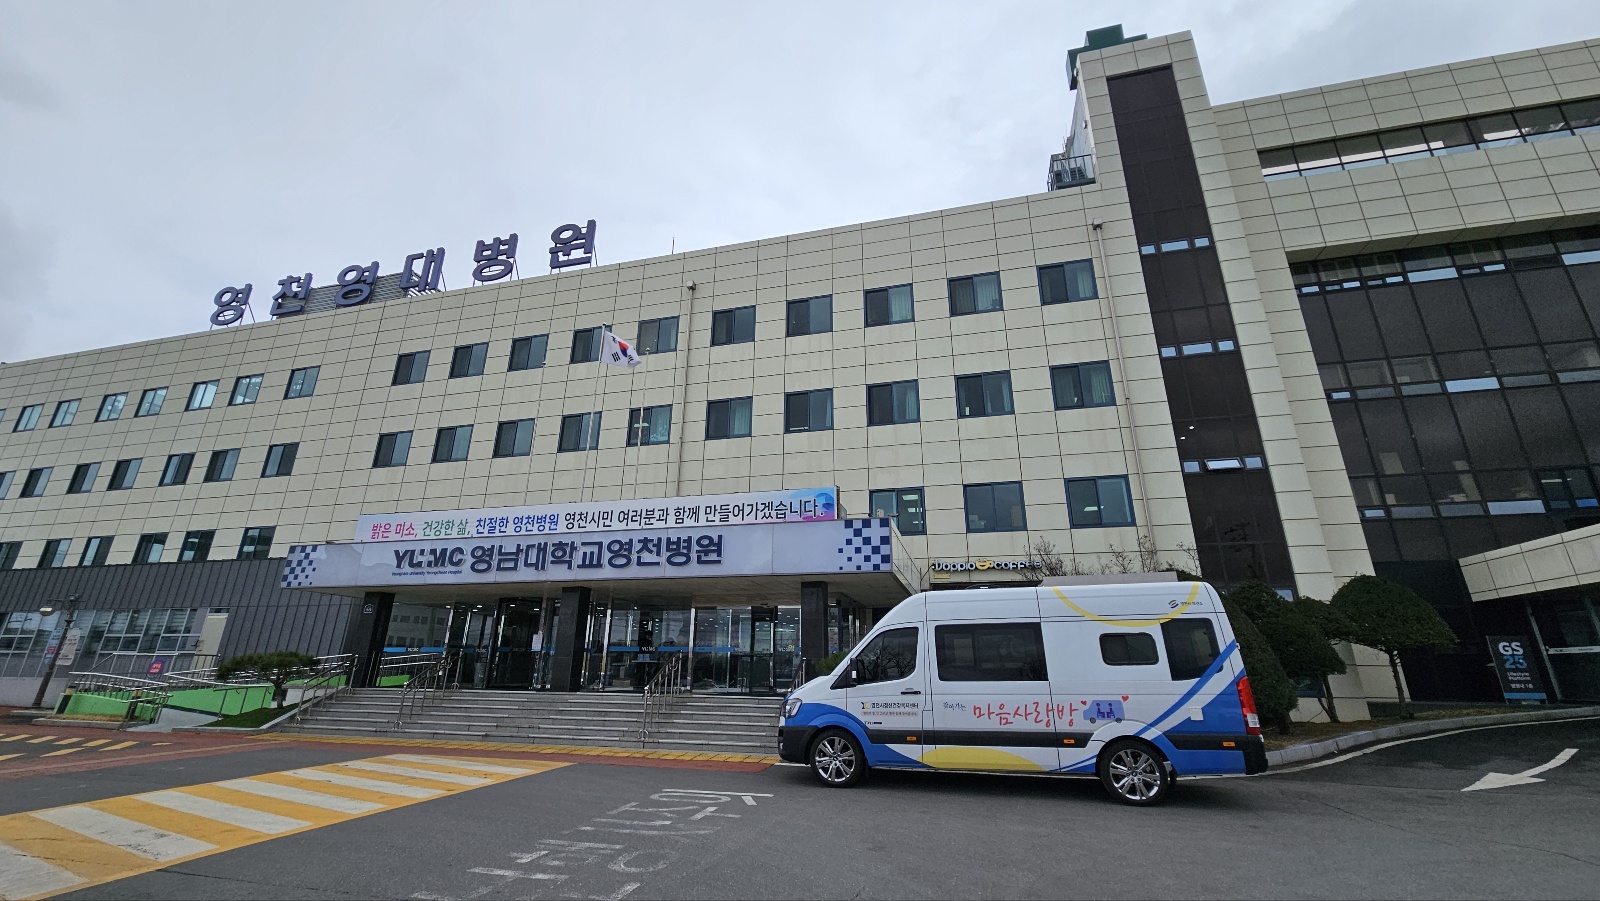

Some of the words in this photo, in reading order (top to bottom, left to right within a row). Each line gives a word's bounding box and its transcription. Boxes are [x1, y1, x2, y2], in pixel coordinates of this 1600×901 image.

[209, 219, 597, 327] 영천영대병원
[371, 522, 392, 540] 밝은
[394, 521, 418, 539] 미소,
[422, 519, 455, 537] 건강한
[475, 516, 510, 536] 친절한
[513, 513, 560, 534] 영천병원
[564, 509, 614, 529] 영천시민
[617, 505, 670, 527] 여러분과
[673, 504, 700, 525] 함께
[704, 498, 825, 524] 만들어가겠습니다.
[470, 534, 724, 573] 영남대학교영천병원
[932, 559, 975, 572] Doppio
[993, 559, 1042, 572] coffee
[1498, 641, 1524, 655] GS
[1503, 655, 1527, 668] 25
[973, 701, 1079, 728] 마음사랑방
